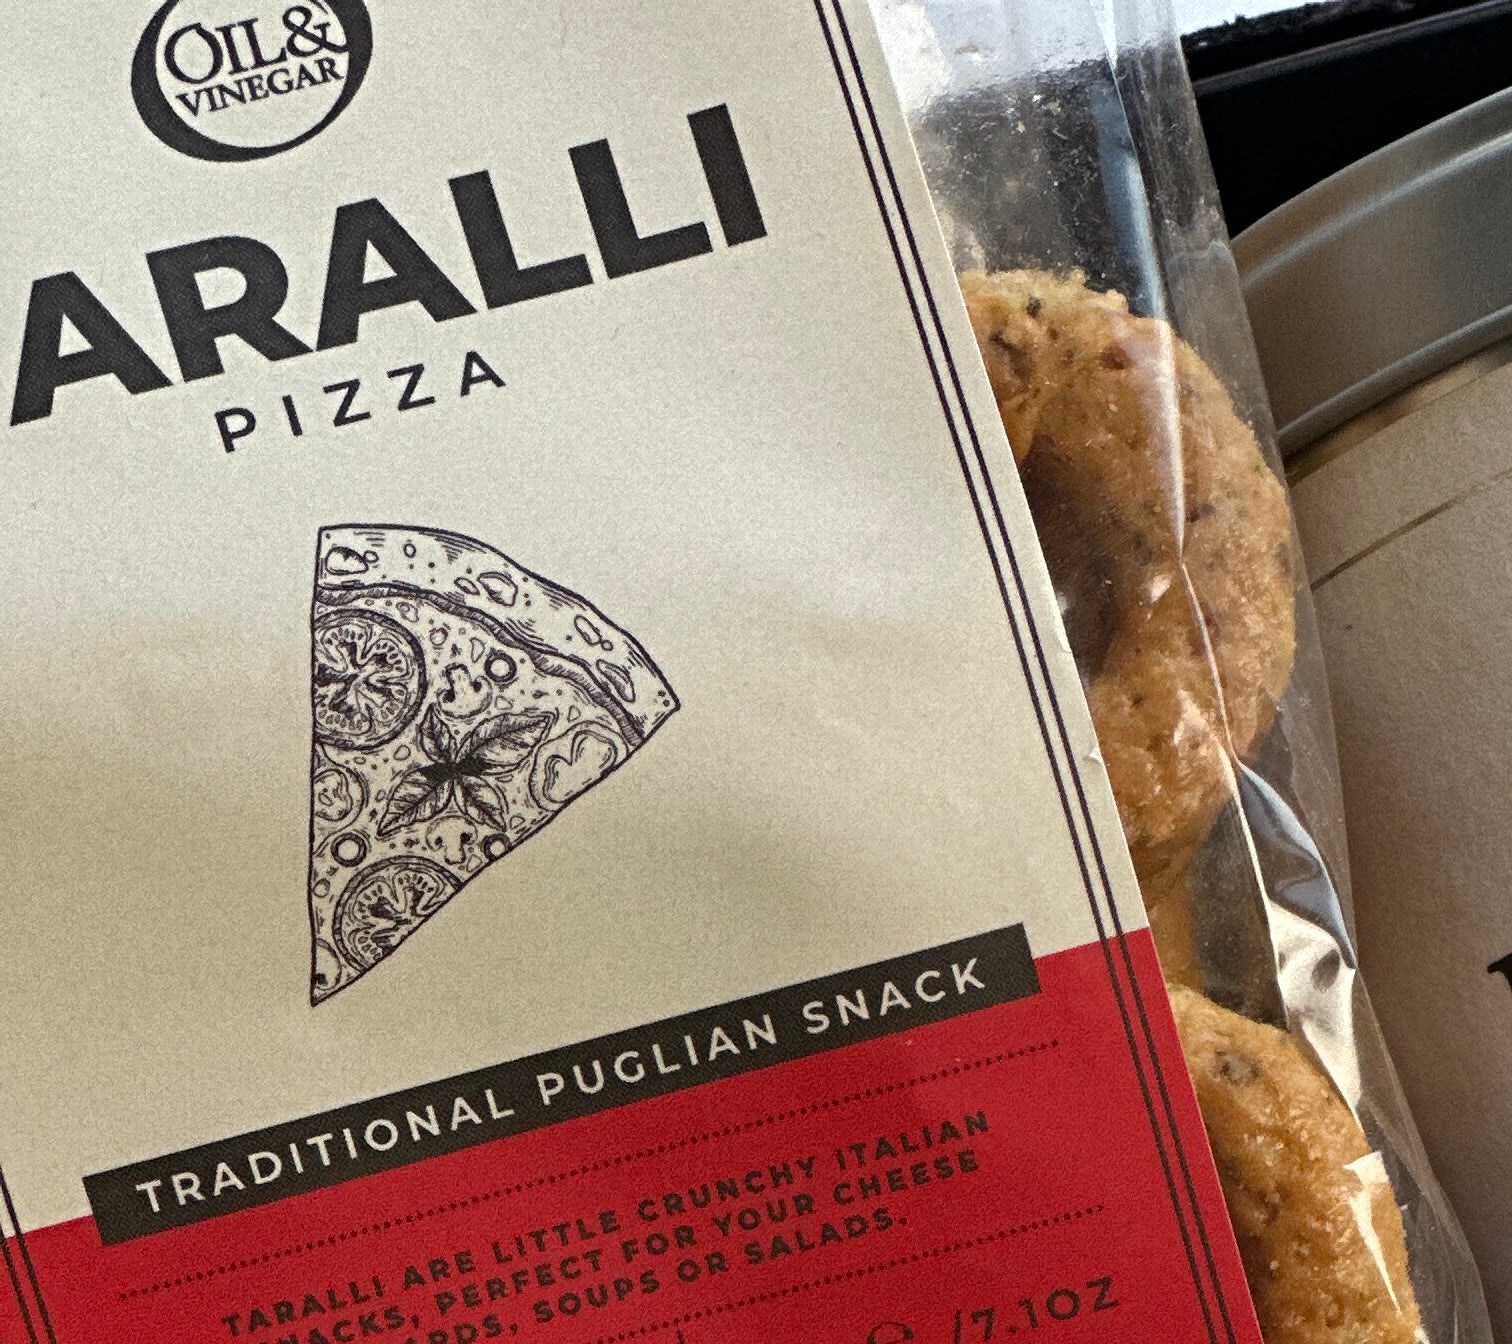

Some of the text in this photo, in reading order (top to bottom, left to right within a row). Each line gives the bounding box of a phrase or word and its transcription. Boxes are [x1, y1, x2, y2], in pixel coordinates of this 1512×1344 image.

[163, 5, 352, 85] OIL&
[175, 55, 346, 118] VINEGAR
[9, 102, 768, 427] ARALLI
[214, 349, 507, 454] PIZZA
[135, 956, 986, 1214] TRADITIONAL PUGLIAN SNACK
[222, 1109, 990, 1338] TARALLI ARE LITTLE CRUNCHY ITALIAN
[433, 1247, 604, 1317] PERFECT
[621, 1223, 697, 1264] FOR
[710, 1192, 815, 1238] YOUR
[832, 1148, 980, 1206] CHEESE
[531, 1269, 661, 1323] SOUPS
[676, 1251, 730, 1283] OR
[743, 1206, 909, 1266] SALADS.
